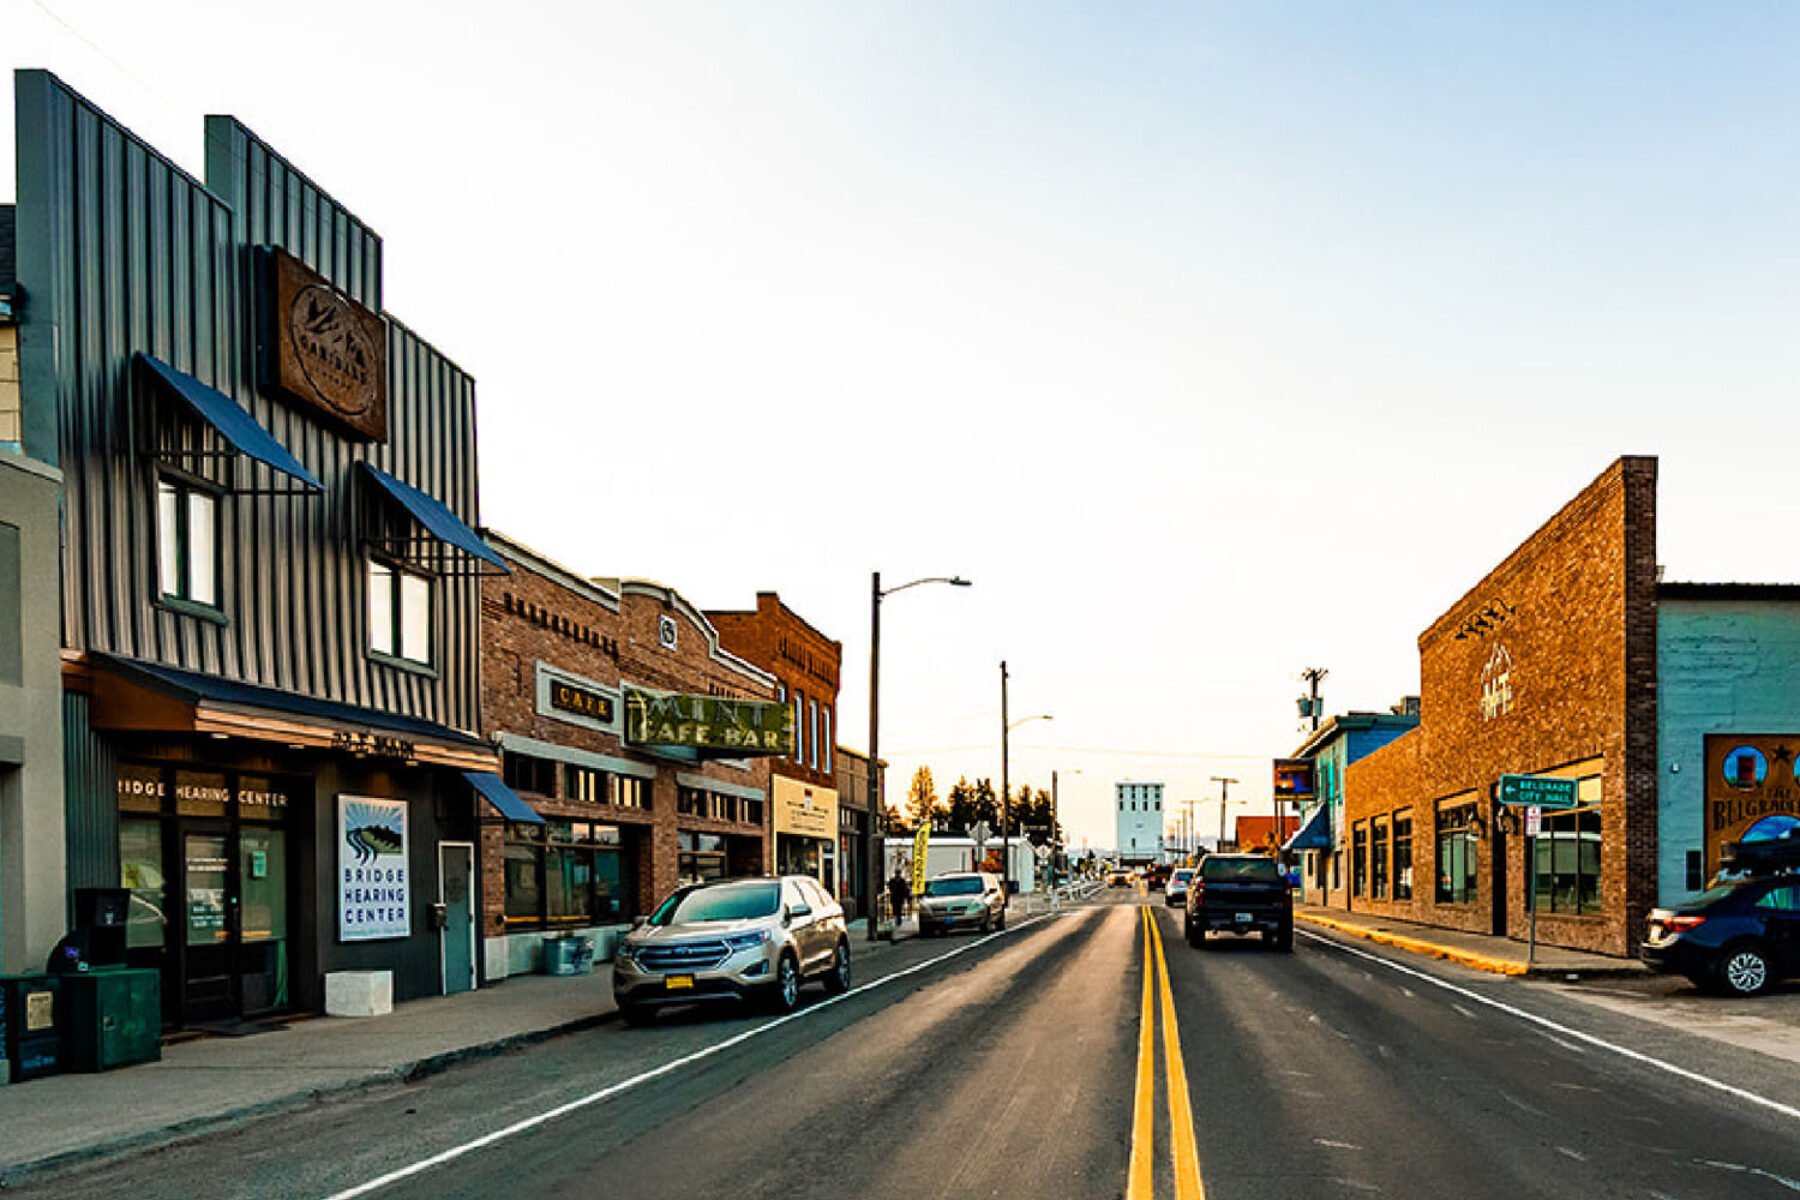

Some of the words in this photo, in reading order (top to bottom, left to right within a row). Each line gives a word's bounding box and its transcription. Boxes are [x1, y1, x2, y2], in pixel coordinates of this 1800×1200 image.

[560, 687, 607, 715] CAFE
[651, 698, 769, 726] MINT
[724, 727, 778, 747] BAR
[175, 785, 231, 802] HEARING
[237, 790, 288, 807] CENTER
[1520, 791, 1541, 801] CITY
[345, 868, 404, 883] BRIDGE
[345, 888, 404, 903] HEARING
[345, 908, 404, 924] CENTER
